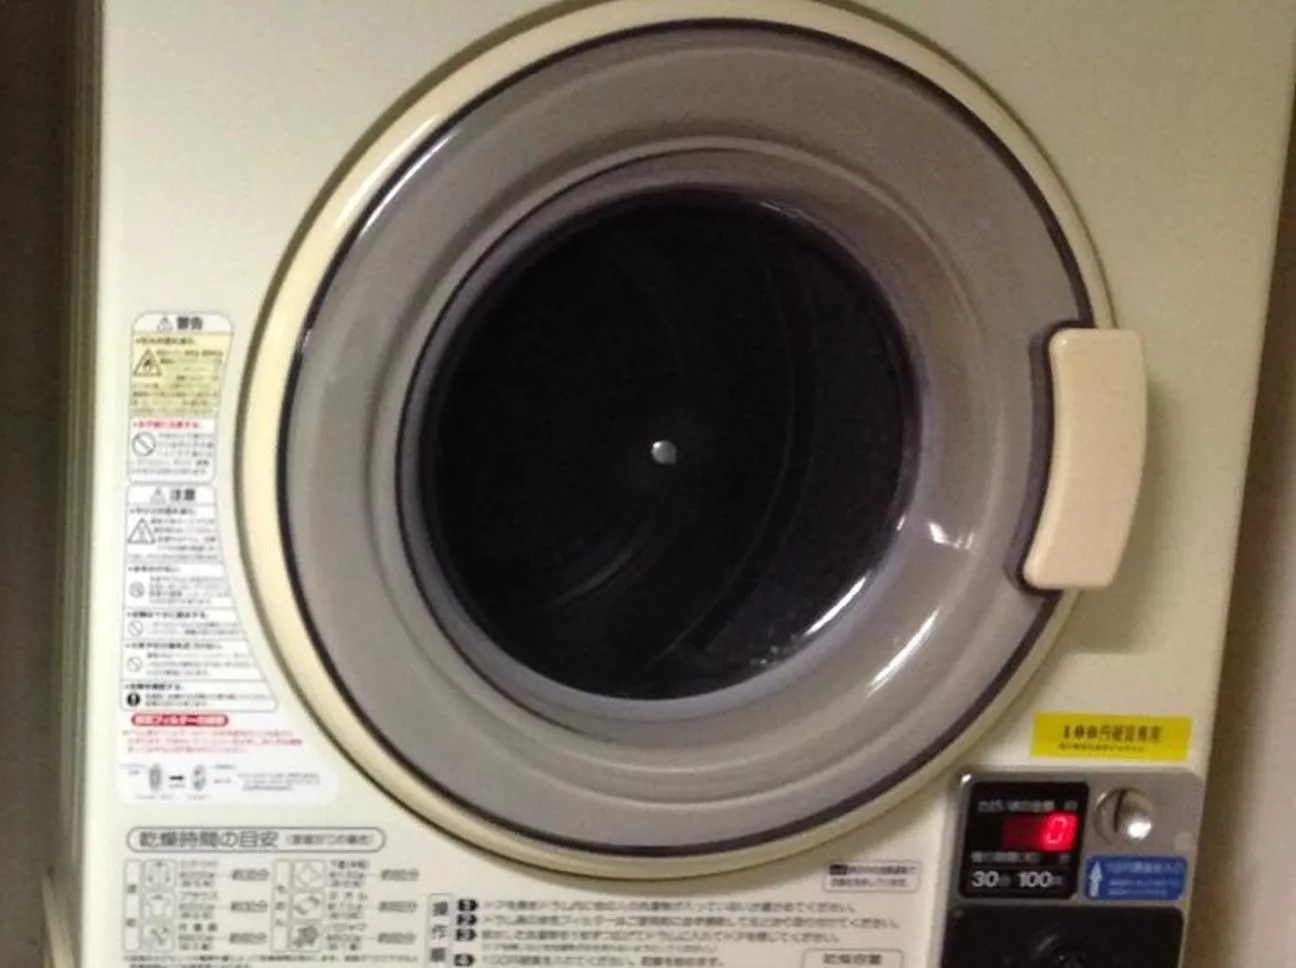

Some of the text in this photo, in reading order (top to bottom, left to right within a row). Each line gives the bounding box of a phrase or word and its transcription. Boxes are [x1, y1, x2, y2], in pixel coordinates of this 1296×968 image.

[138, 830, 279, 848] 乾燥時間の目安
[1045, 814, 1068, 844] 0
